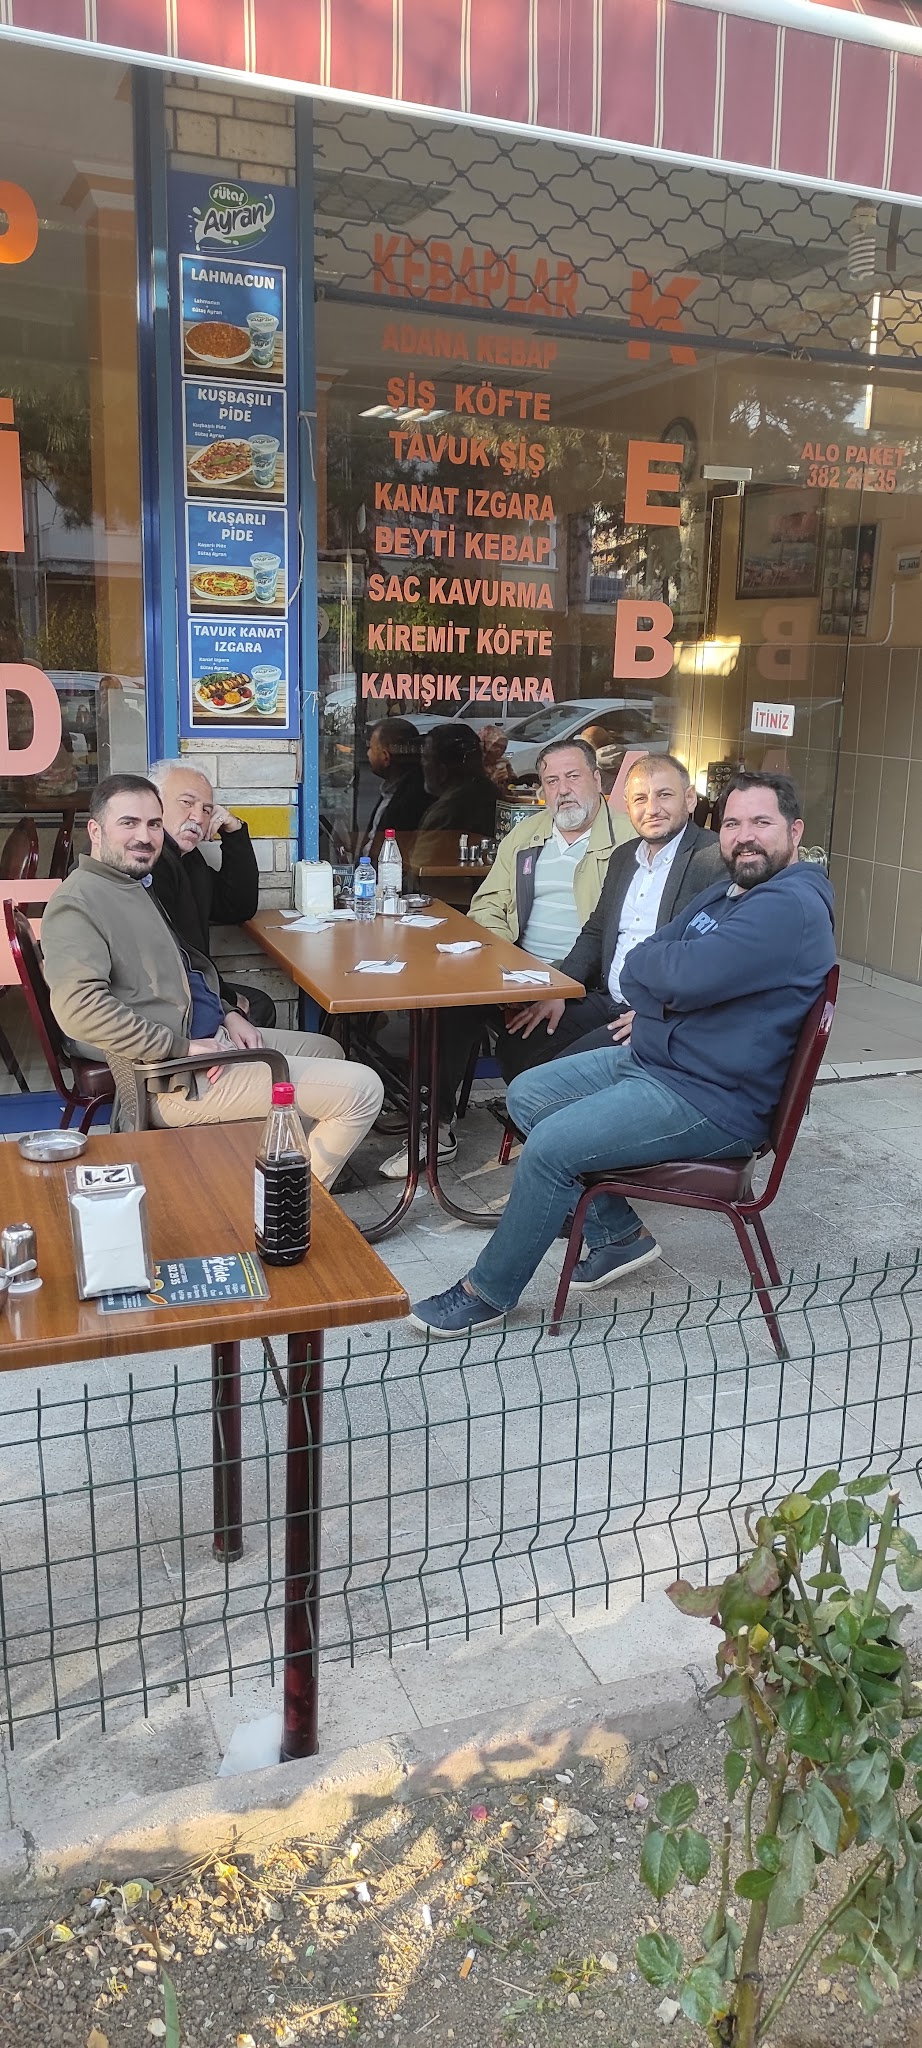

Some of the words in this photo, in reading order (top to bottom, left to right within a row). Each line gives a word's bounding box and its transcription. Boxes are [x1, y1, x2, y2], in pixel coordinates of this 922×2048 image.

[212, 184, 246, 206] sütaş
[203, 203, 265, 236] Ayran
[191, 267, 275, 290] LAHMACUN
[373, 234, 578, 319] KEBAPLAR
[382, 323, 469, 361] ADANA
[476, 334, 558, 369] KEBAP
[197, 387, 272, 408] KUŞBAŞILI
[386, 372, 436, 412] ŞİŞ
[454, 382, 552, 422] KÖFTE
[219, 405, 252, 423] PİDE
[388, 431, 490, 468] TAVUK
[498, 438, 546, 478] ŞİŞ
[800, 441, 840, 462] ALO
[845, 445, 906, 469] PAKET
[807, 463, 840, 488] 382
[876, 469, 897, 492] 35
[374, 482, 460, 516] KANAT
[467, 489, 556, 522] IZGARA
[207, 510, 266, 528] KAŞARLI
[221, 525, 254, 542] PİDE
[374, 525, 456, 558] BEYTİ
[464, 531, 552, 563] KEBAP
[368, 574, 421, 604] SAC
[428, 576, 554, 610] KAVURMA
[193, 624, 236, 638] TAVUK
[239, 625, 283, 639] KANAT
[367, 619, 470, 654] KİREMİT
[476, 623, 553, 657] KÖFTE
[214, 641, 263, 653] IZGARA
[361, 672, 462, 707] KARIŞIK
[469, 675, 556, 703] IZGARA
[755, 707, 790, 730] İTİNİZ
[84, 1168, 127, 1187] 21
